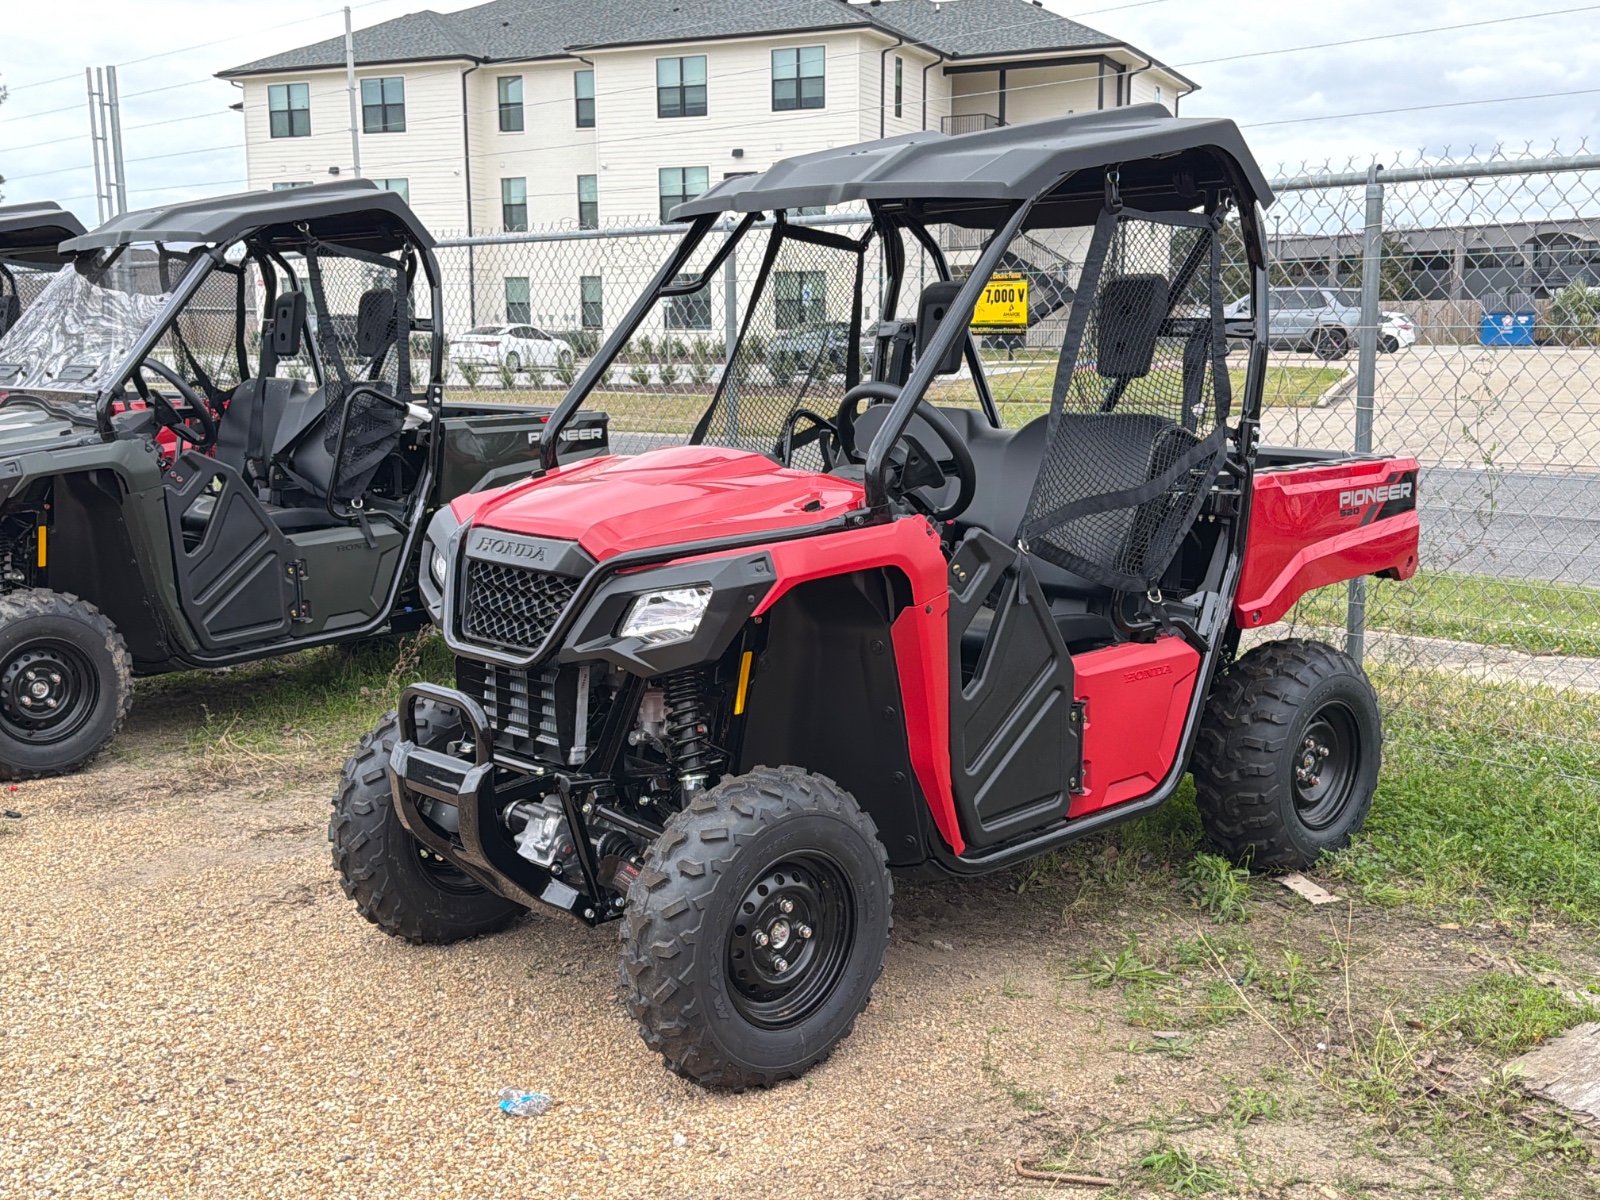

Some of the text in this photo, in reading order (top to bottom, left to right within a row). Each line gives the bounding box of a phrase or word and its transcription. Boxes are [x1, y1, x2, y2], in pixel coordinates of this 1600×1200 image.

[986, 289, 1025, 305] 7,000 V
[1340, 482, 1413, 508] PIONEER
[1340, 508, 1360, 517] 520
[475, 537, 548, 562] HONDA
[1123, 664, 1173, 683] HONDA
